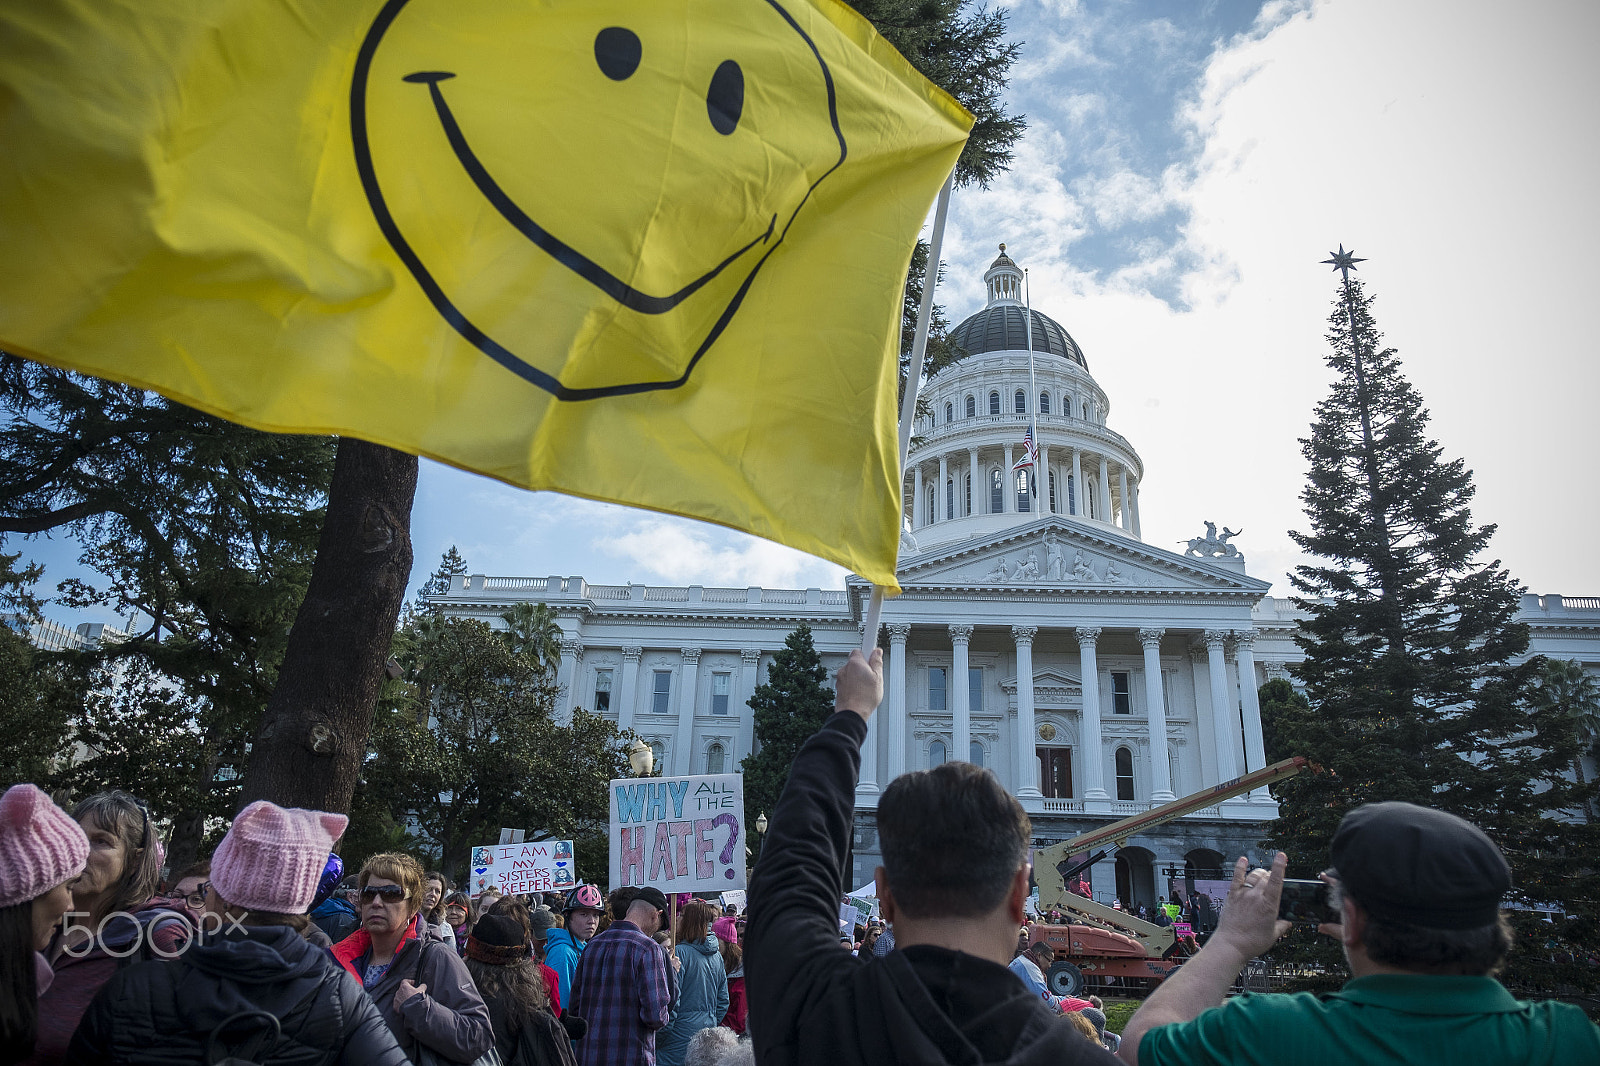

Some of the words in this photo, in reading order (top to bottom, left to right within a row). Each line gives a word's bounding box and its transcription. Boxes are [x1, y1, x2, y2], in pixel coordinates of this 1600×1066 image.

[615, 781, 689, 823] WHY
[694, 782, 734, 796] ALL
[693, 796, 735, 811] THE
[499, 847, 515, 860] I
[520, 846, 548, 858] AM
[620, 812, 739, 886] HATE?
[512, 858, 537, 870] MY
[498, 868, 551, 883] SISTERS
[501, 878, 552, 895] KEEPER
